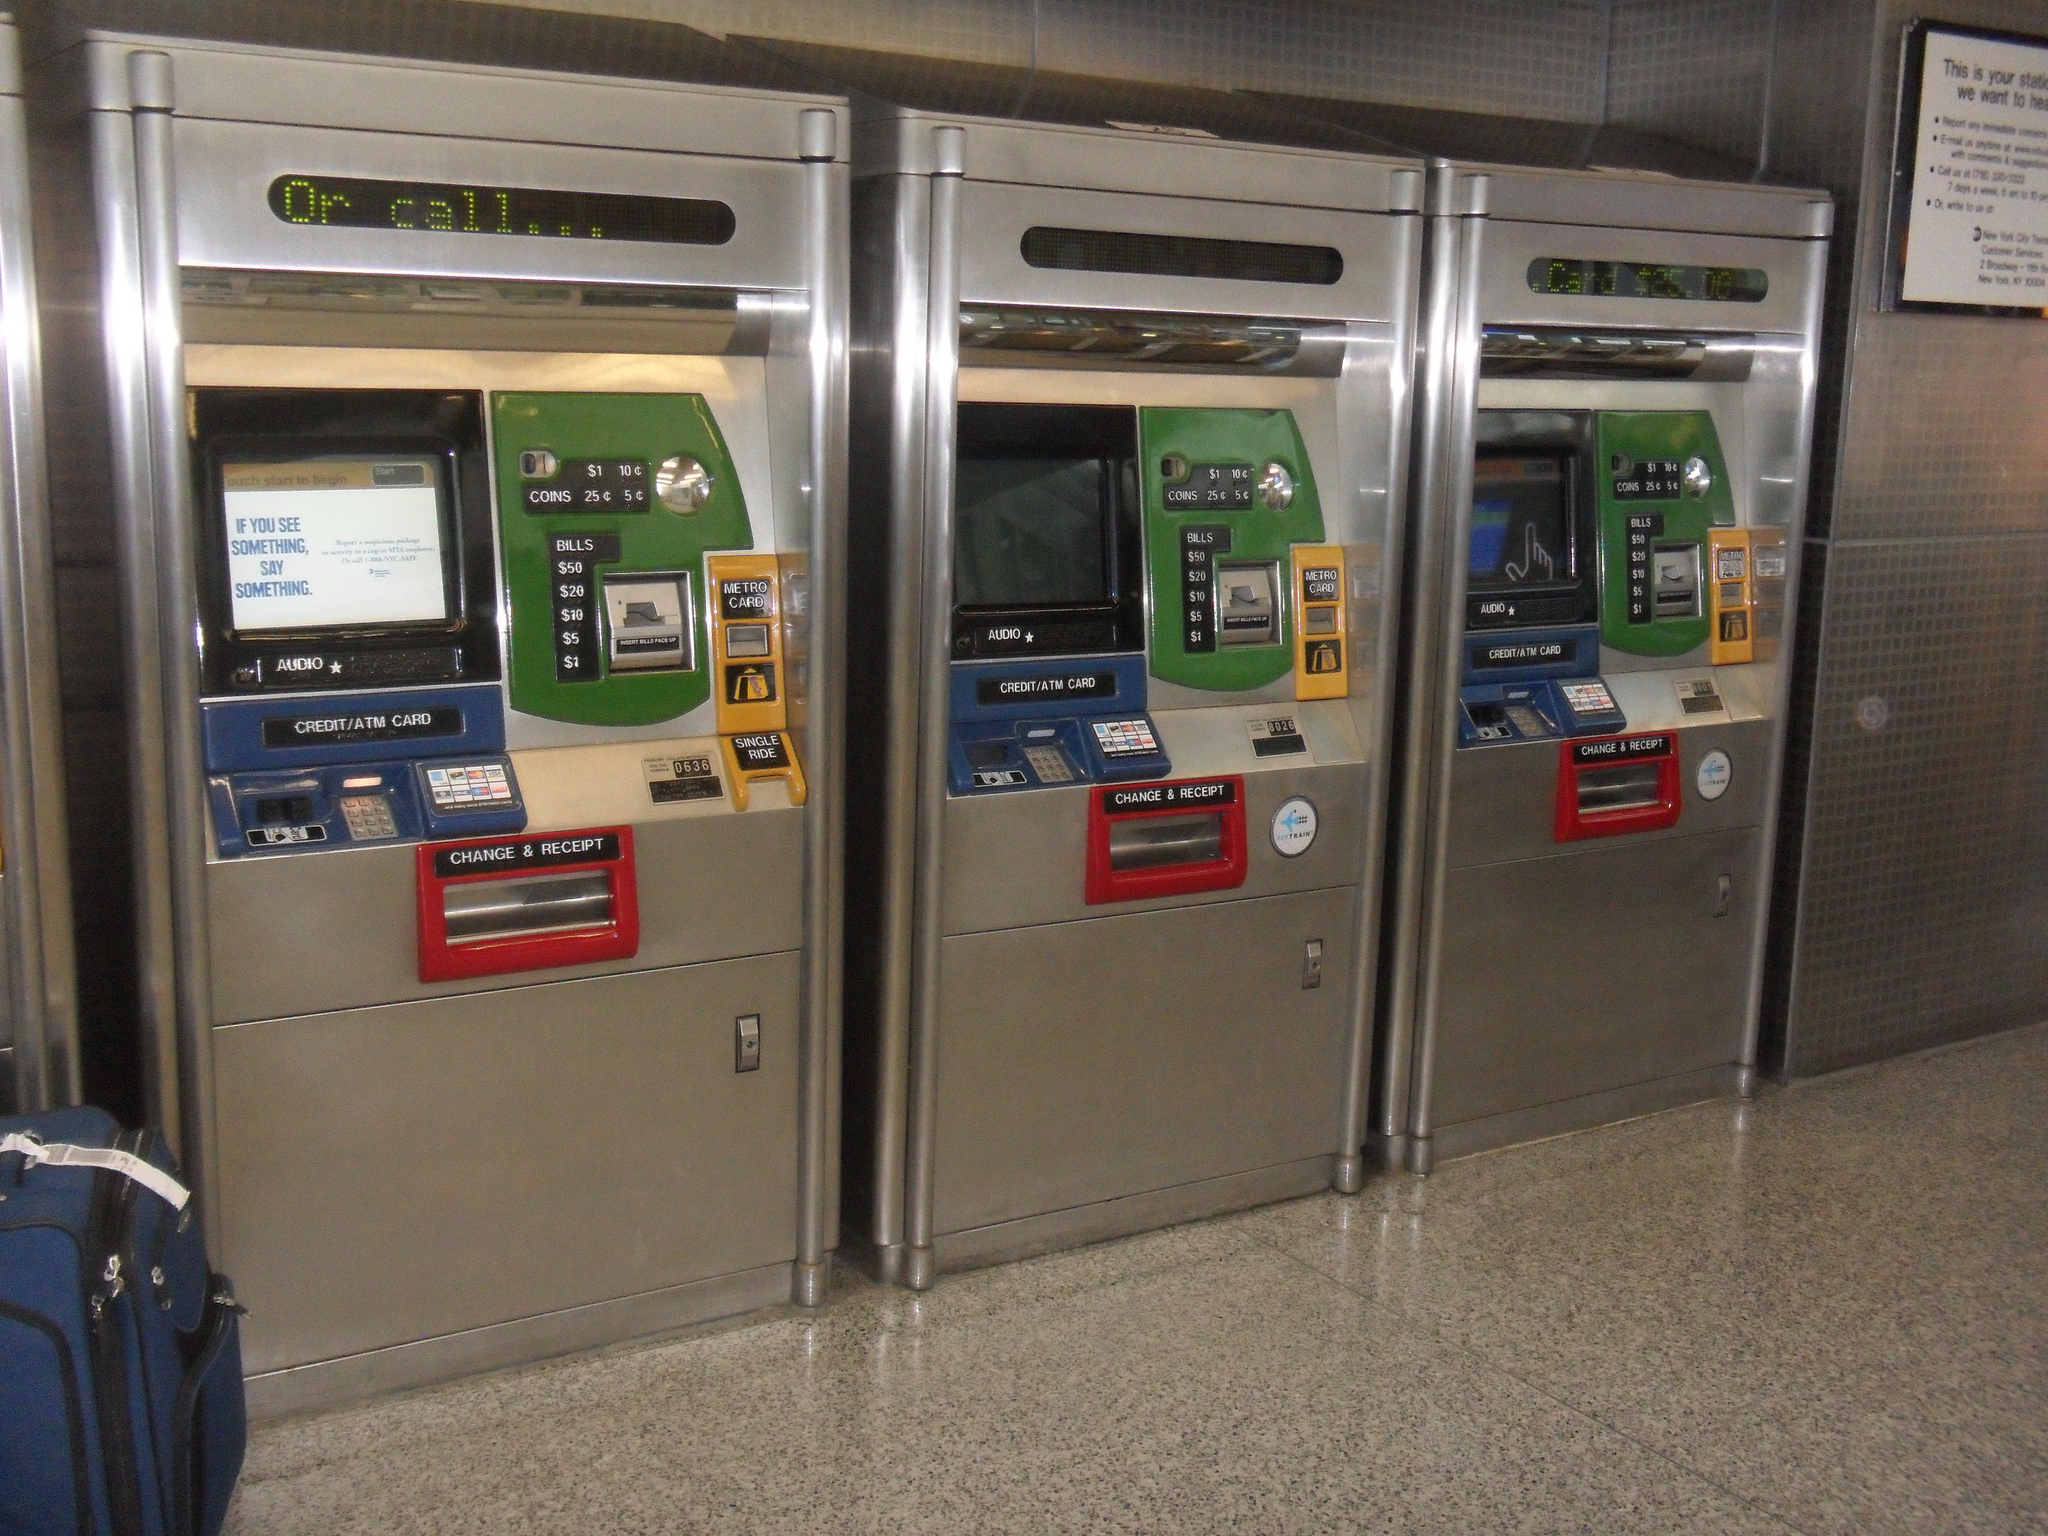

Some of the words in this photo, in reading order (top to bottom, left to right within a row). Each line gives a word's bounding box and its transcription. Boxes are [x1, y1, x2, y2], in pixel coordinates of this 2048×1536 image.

[1944, 58, 1968, 78] This
[1973, 64, 1983, 81] is
[1988, 70, 2014, 86] your
[1957, 87, 1975, 101] we
[1980, 89, 2007, 105] want
[2013, 91, 2025, 107] to
[1938, 165, 1951, 176] Call
[1953, 169, 1961, 178] us
[1963, 170, 1971, 179] at
[1955, 183, 1971, 195] days
[284, 180, 351, 223] Or
[1947, 202, 1964, 211] write
[1966, 203, 1974, 212] to
[1976, 205, 1984, 213] us
[1986, 260, 2018, 273] Broadway
[1978, 274, 1992, 284] New
[375, 467, 397, 476] Start
[587, 464, 603, 478] $1
[619, 464, 631, 477] 10
[1209, 468, 1220, 480] $1
[1231, 469, 1240, 479] 10
[1647, 463, 1656, 473] $1
[226, 475, 260, 487] ouch
[264, 475, 294, 487] start
[296, 475, 309, 486] to
[313, 473, 348, 487] begin
[1616, 483, 1639, 492] COINS
[1646, 483, 1655, 492] 25
[529, 490, 572, 503] COINS
[584, 490, 600, 502] 25
[624, 489, 632, 502] 5
[1168, 490, 1198, 501] COINS
[1207, 490, 1218, 501] 25
[1235, 490, 1241, 500] 5
[236, 519, 247, 533] IF
[250, 518, 275, 533] YOU
[279, 517, 300, 533] SEE
[1631, 518, 1651, 528] BILLS
[336, 539, 357, 547] Report
[396, 538, 420, 546] package
[1187, 532, 1213, 543] BILLS
[1631, 535, 1645, 544] $50
[232, 538, 309, 556] SOMETHING,
[556, 539, 594, 552] BILLS
[1188, 552, 1205, 562] $50
[1632, 552, 1646, 562] $20
[260, 560, 284, 576] SAY
[557, 561, 583, 575] $50
[1632, 570, 1645, 579] $10
[1188, 572, 1206, 582] $20
[1305, 570, 1337, 581] METRO
[235, 580, 313, 598] SOMETHING.
[559, 585, 585, 598] $20
[724, 581, 768, 595] METRO
[1309, 584, 1334, 593] CARD
[1633, 587, 1643, 597] $5
[729, 596, 765, 609] CARD
[1189, 592, 1205, 602] $10
[1481, 603, 1505, 614] AUDIO
[1633, 604, 1642, 614] $1
[561, 609, 584, 622] $10
[1190, 611, 1202, 622] $5
[562, 632, 580, 646] $5
[988, 628, 1021, 641] AUDIO
[1191, 632, 1201, 642] $1
[1489, 646, 1537, 659] CREDIT/ATM
[1540, 645, 1561, 656] CARD
[275, 657, 323, 672] AUDIO
[563, 655, 580, 669] $1
[1000, 679, 1063, 694] CREDIT/ATM
[1068, 677, 1096, 689] CARD
[295, 716, 386, 734] CREDIT/ATM
[392, 713, 432, 728] CARD
[735, 735, 780, 749] SINGLE
[1581, 742, 1616, 756] CHANGE
[1620, 742, 1626, 752] &
[1629, 738, 1663, 751] RECEIPT
[748, 749, 777, 760] RIDE
[674, 759, 710, 774] 0636
[1115, 789, 1161, 805] CHANGE
[1167, 789, 1175, 800] &
[1180, 785, 1224, 799] RECEIPT
[450, 846, 516, 865] CHANGE
[523, 845, 534, 858] &
[541, 838, 604, 857] RECEIPT
